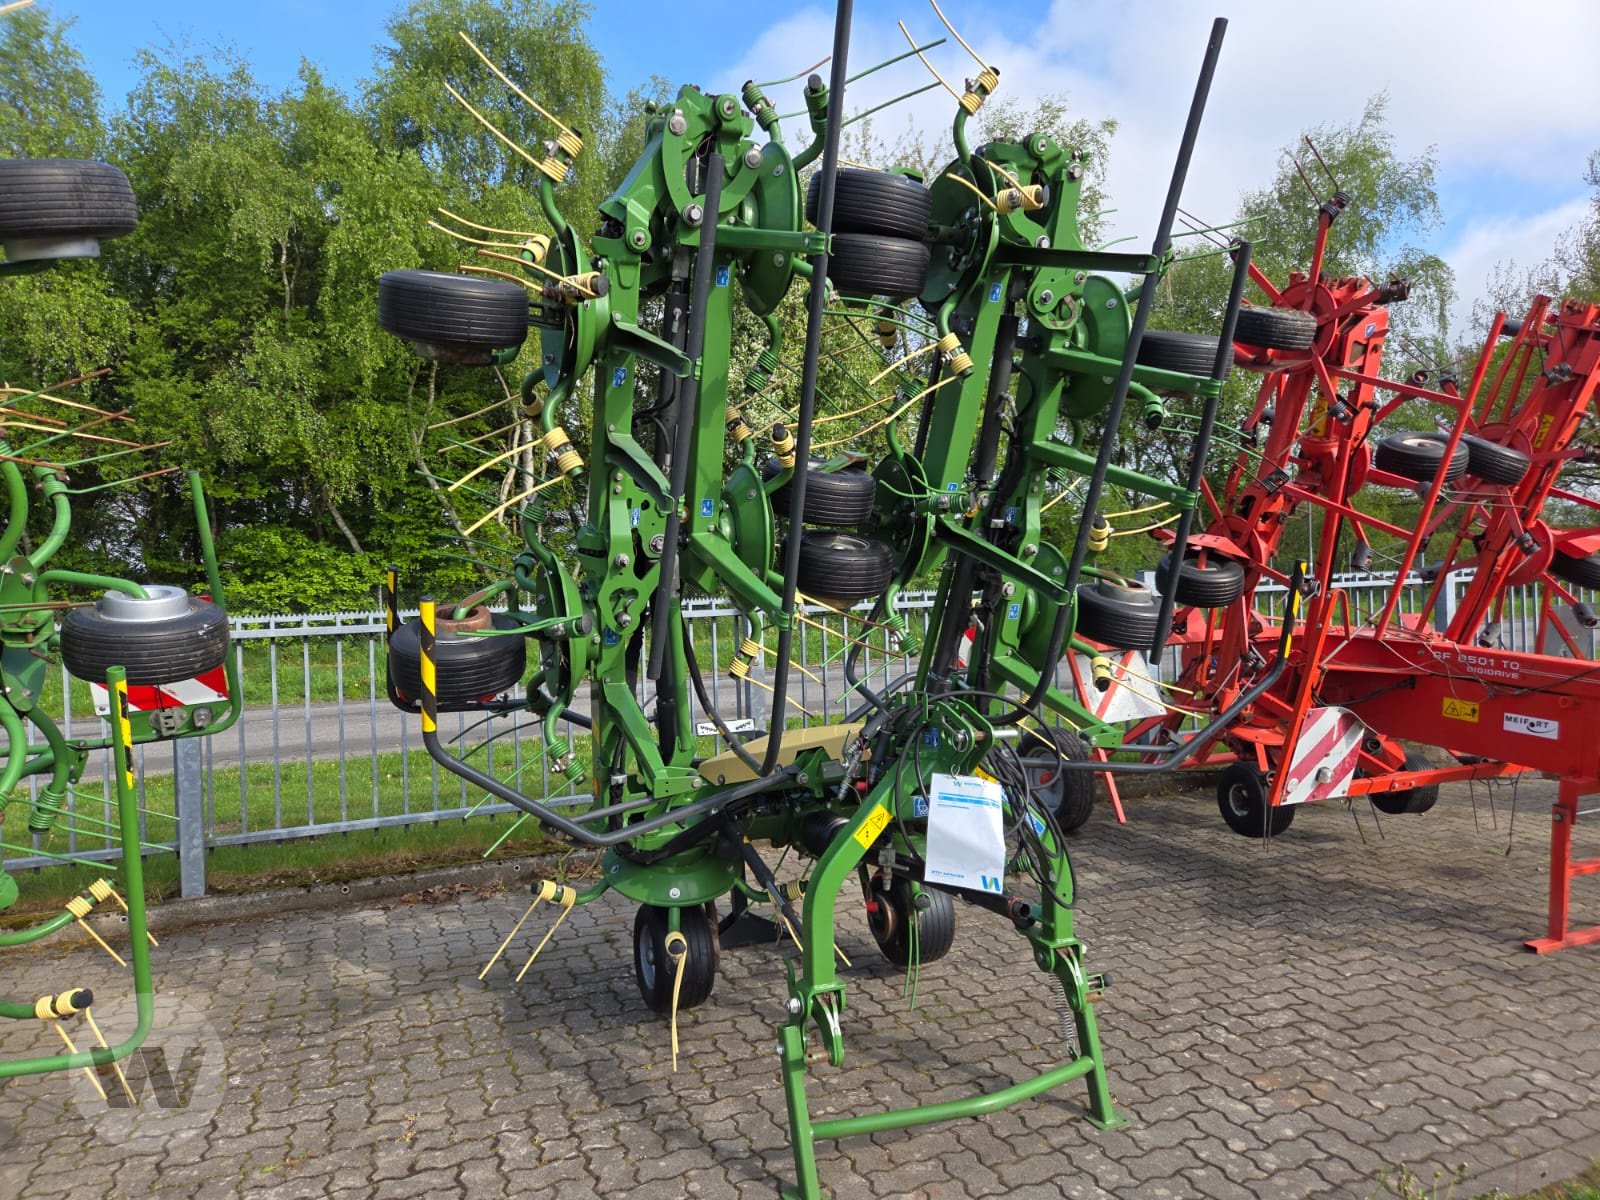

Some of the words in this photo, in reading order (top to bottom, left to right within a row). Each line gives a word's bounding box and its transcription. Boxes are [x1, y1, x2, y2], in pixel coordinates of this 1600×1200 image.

[1458, 654, 1495, 667] 8501
[1502, 660, 1520, 670] TO
[1466, 665, 1519, 680] DIGIDRIVE
